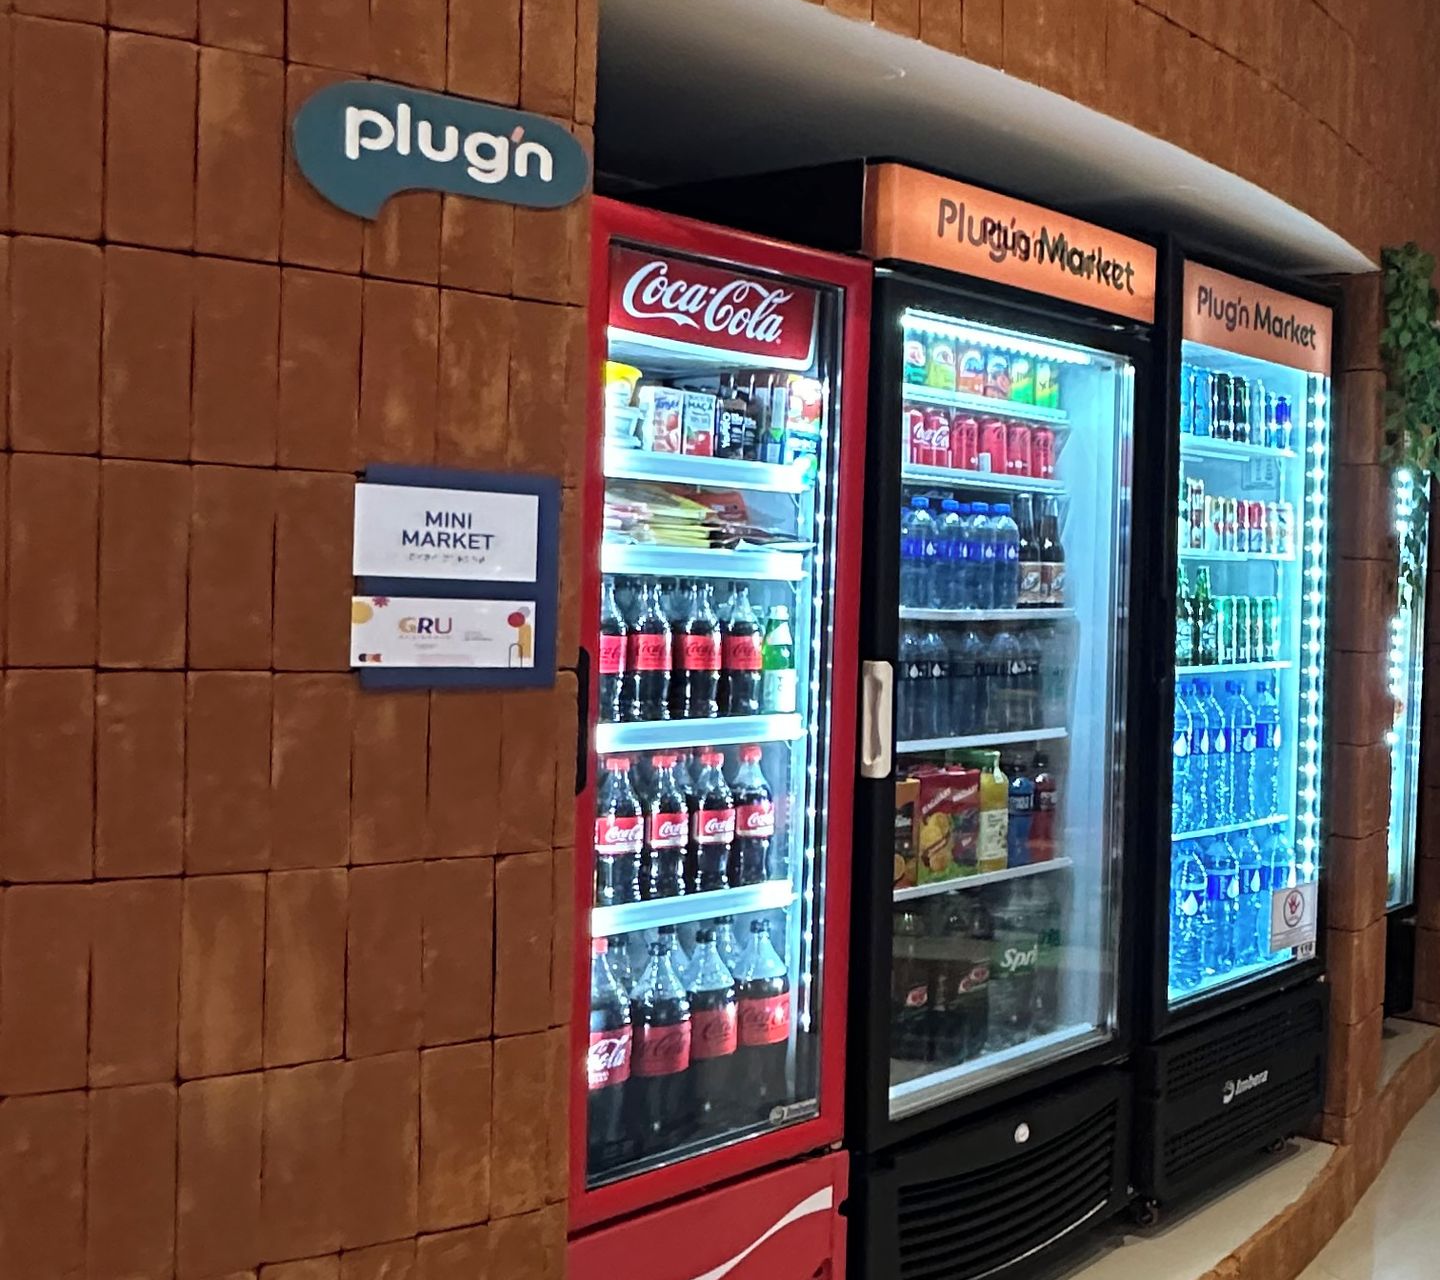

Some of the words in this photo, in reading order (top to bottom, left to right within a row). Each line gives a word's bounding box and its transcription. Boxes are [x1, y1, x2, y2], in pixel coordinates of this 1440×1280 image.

[622, 261, 794, 344] Coca-Cola
[1197, 284, 1250, 332] Plug'n
[1253, 302, 1318, 351] Market
[425, 510, 473, 530] MINI
[402, 529, 495, 551] MARKET
[398, 617, 453, 634] GRU
